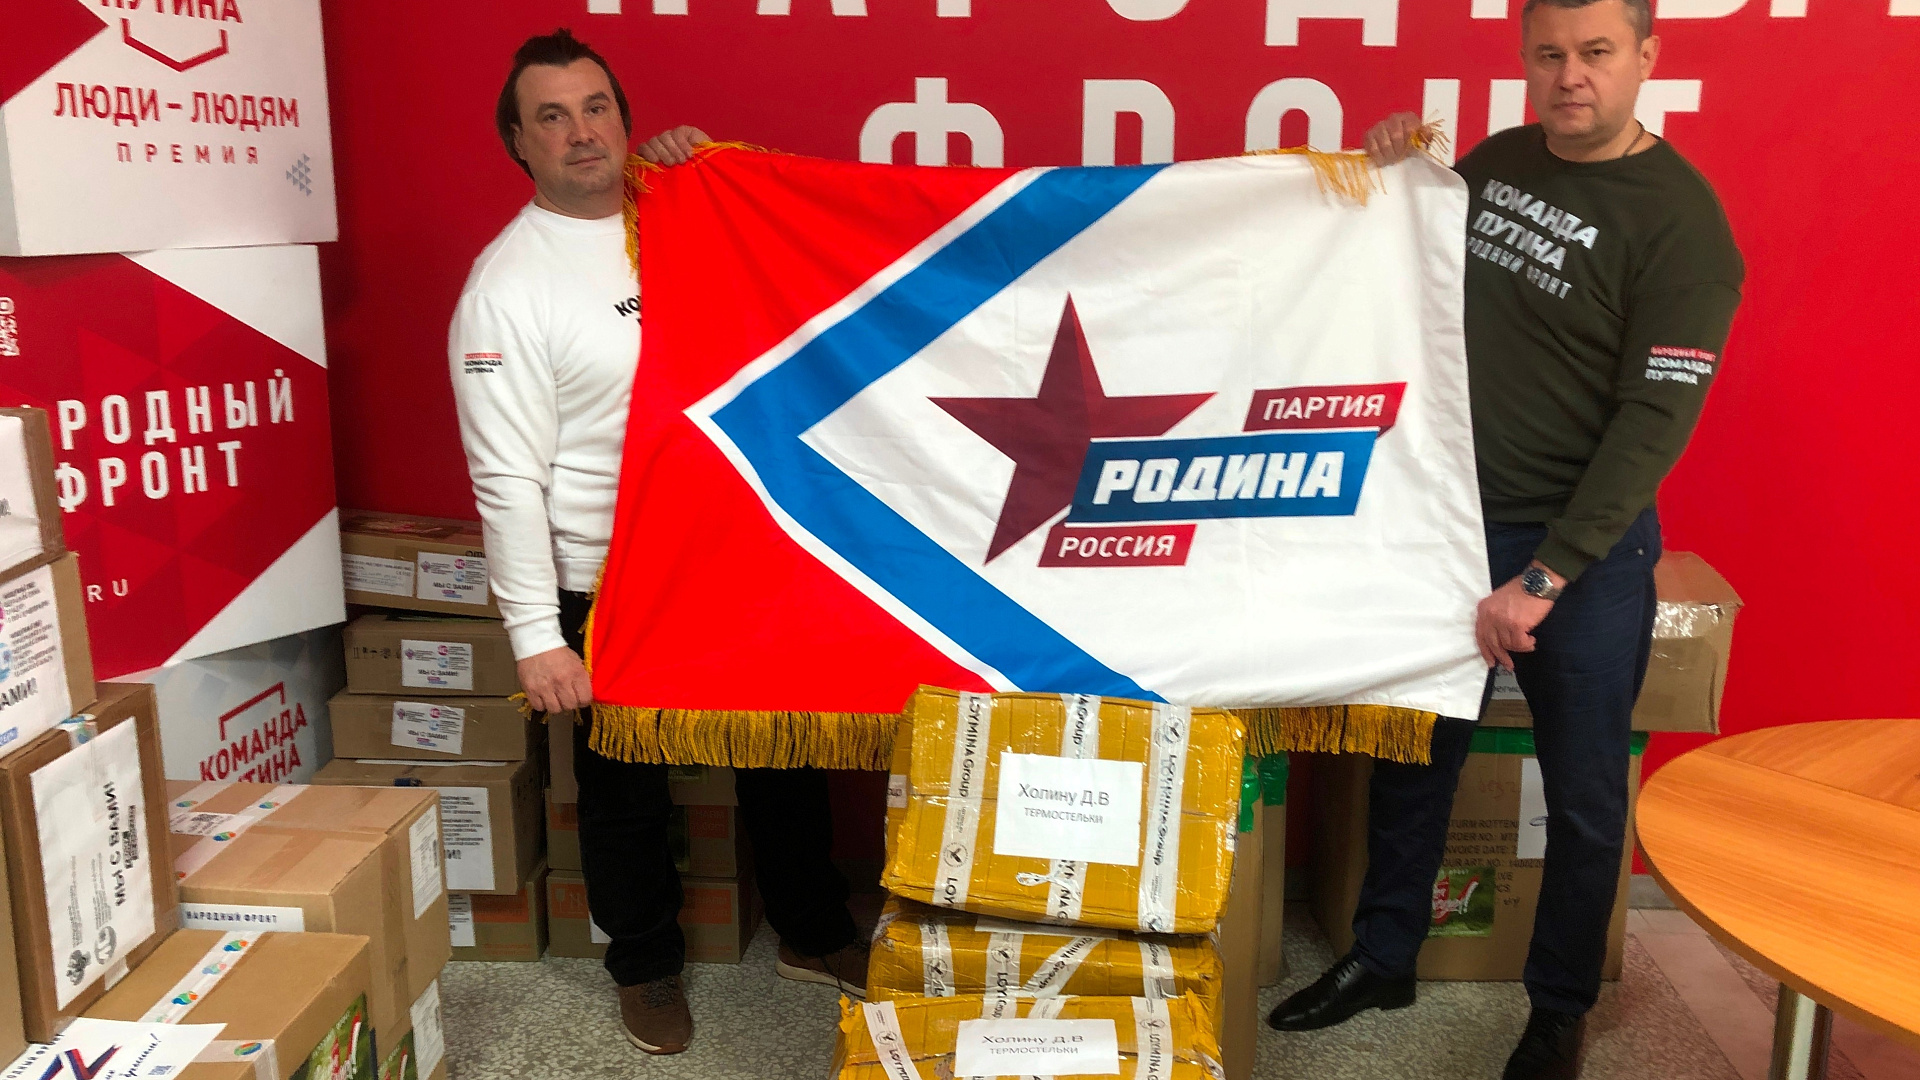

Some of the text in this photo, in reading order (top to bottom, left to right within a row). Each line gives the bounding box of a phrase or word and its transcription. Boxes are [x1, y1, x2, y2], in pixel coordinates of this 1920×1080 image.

[53, 82, 161, 127] ЛЮДИ
[190, 91, 300, 132] ЛЮДЯМ
[116, 142, 259, 164] ПРЕМИЯ
[1480, 178, 1600, 250] КОМАНДА
[613, 294, 642, 317] КО
[57, 369, 295, 450] РОДНЫЙ
[1263, 394, 1386, 421] ПАРТИЯ
[54, 441, 242, 513] ФРОНТ
[1091, 451, 1345, 505] РОДИНА
[1058, 535, 1176, 559] РОССИЯ
[200, 702, 307, 782] КОМАНДА
[965, 696, 981, 757] LOYMINA
[1073, 706, 1089, 745] Group
[238, 743, 301, 784] ТИНА
[959, 758, 975, 797] Group
[1017, 783, 1078, 807] Холину
[1024, 807, 1104, 825] ТЕРМОСТЕЛЬКИ
[1448, 833, 1478, 842] RDER
[982, 1035, 1047, 1045] Холину
[989, 1046, 1079, 1056] ТЕРМОСТЕЛЬКИ
